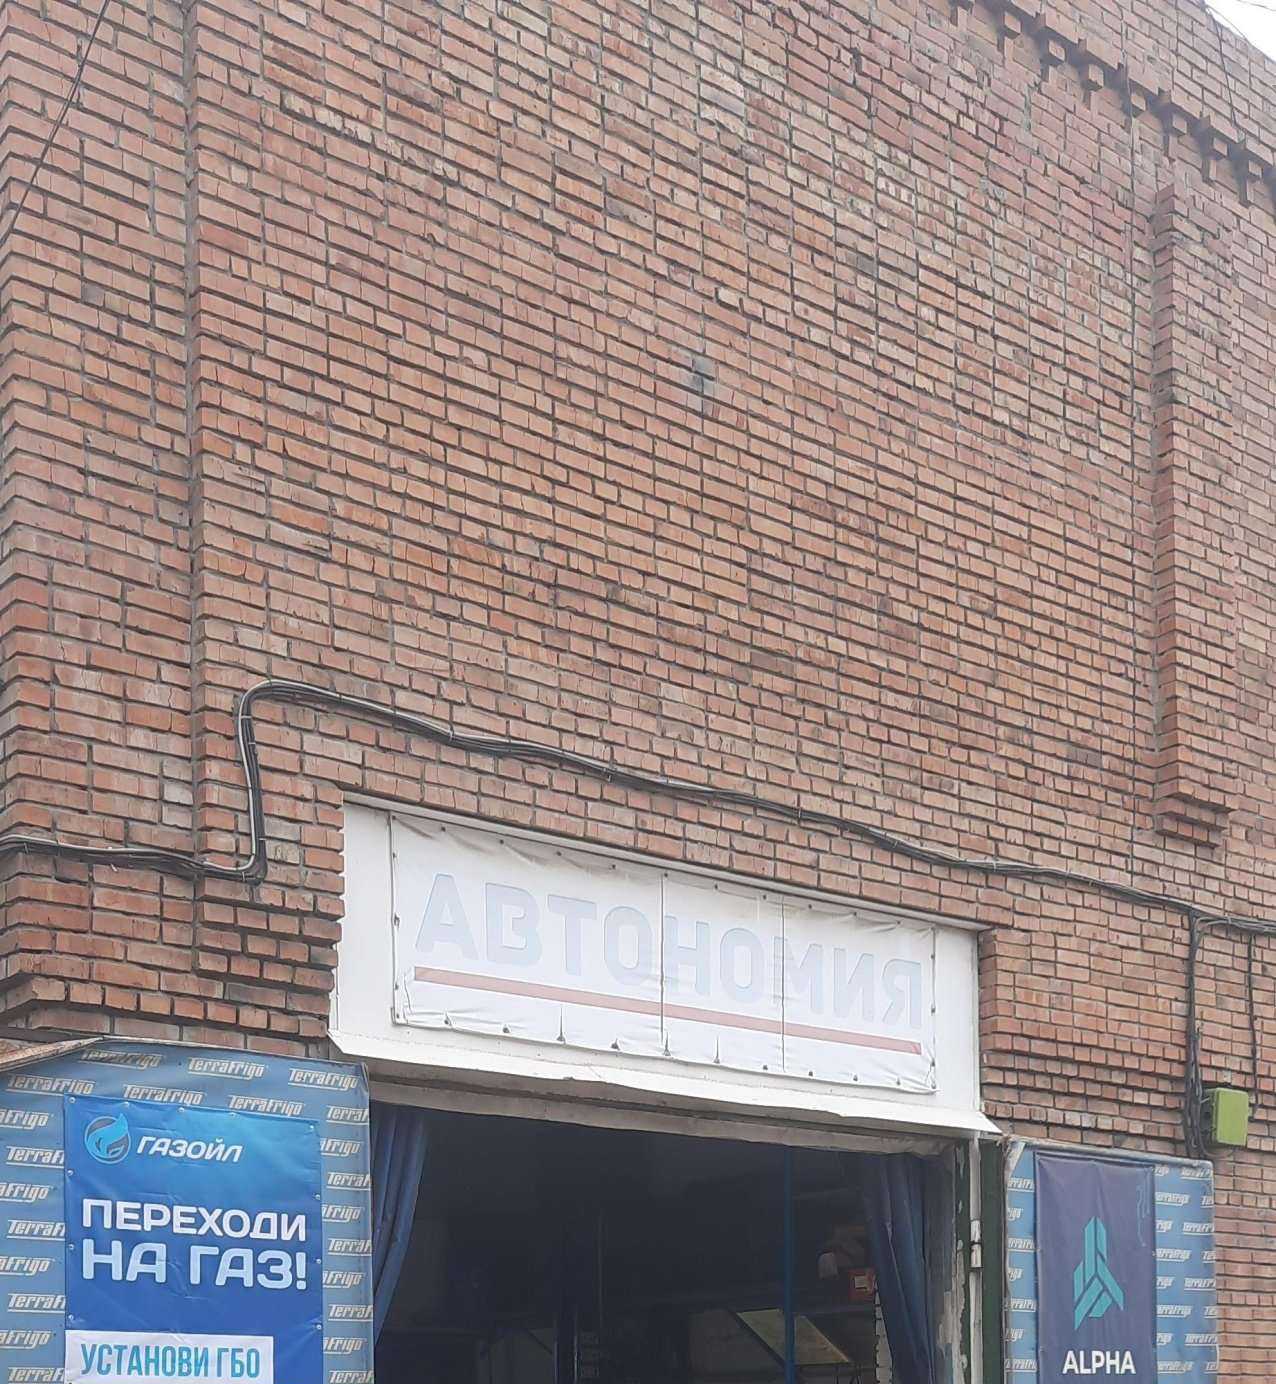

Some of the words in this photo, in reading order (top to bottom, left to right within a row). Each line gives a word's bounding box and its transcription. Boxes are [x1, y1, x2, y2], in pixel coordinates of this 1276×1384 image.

[414, 871, 923, 1030] АВТОНОМИЯ
[137, 1136, 243, 1163] ГАЗОЙЛ
[82, 1198, 306, 1242] ПЕРЕХОДИ
[82, 1238, 167, 1283] НА
[189, 1245, 307, 1290] ГАЗ!
[80, 1343, 209, 1377] УСТАНОВИ
[216, 1346, 261, 1378] ГБО
[1062, 1350, 1137, 1375] ALPHA
